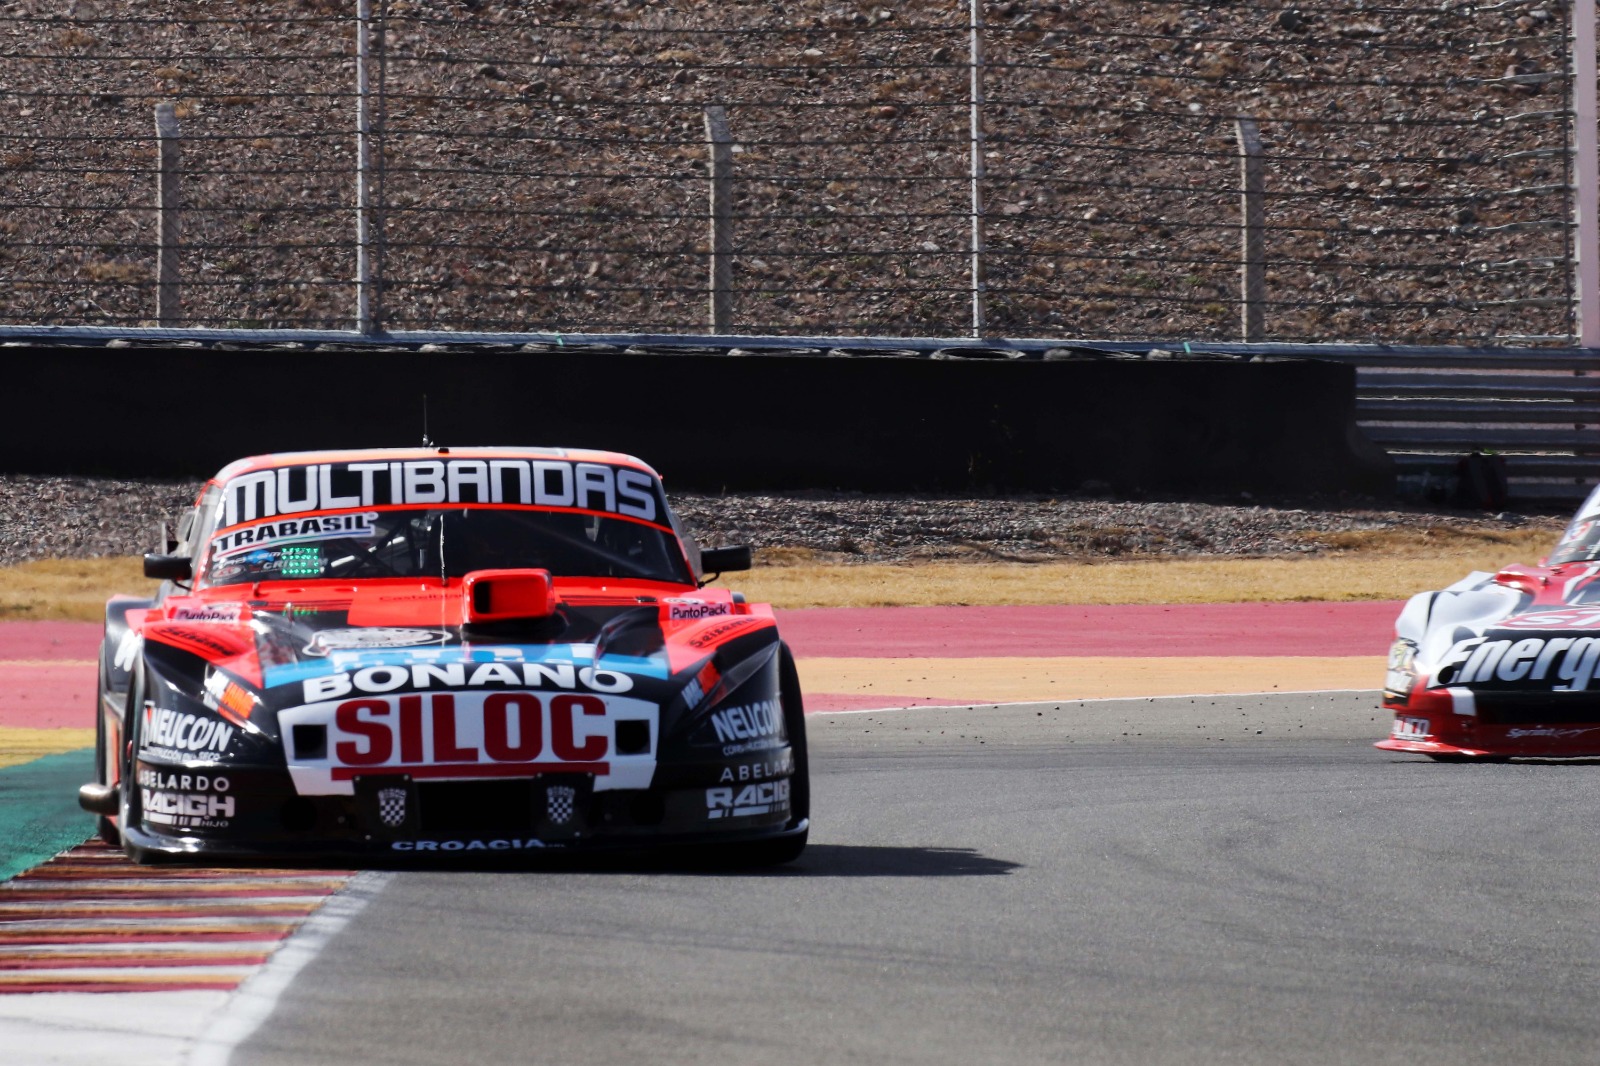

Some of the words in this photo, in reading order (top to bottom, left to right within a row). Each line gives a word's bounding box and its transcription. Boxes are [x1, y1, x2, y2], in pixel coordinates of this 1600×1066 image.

[225, 460, 656, 527] MULTIBANDAS
[216, 514, 372, 552] TRABASIL
[671, 604, 728, 620] PuntoPack
[303, 663, 634, 703] BONANO
[148, 707, 234, 752] NEUCON
[335, 692, 609, 766] SILOC
[142, 788, 236, 818] RACIGH
[391, 838, 546, 851] CROACIA
